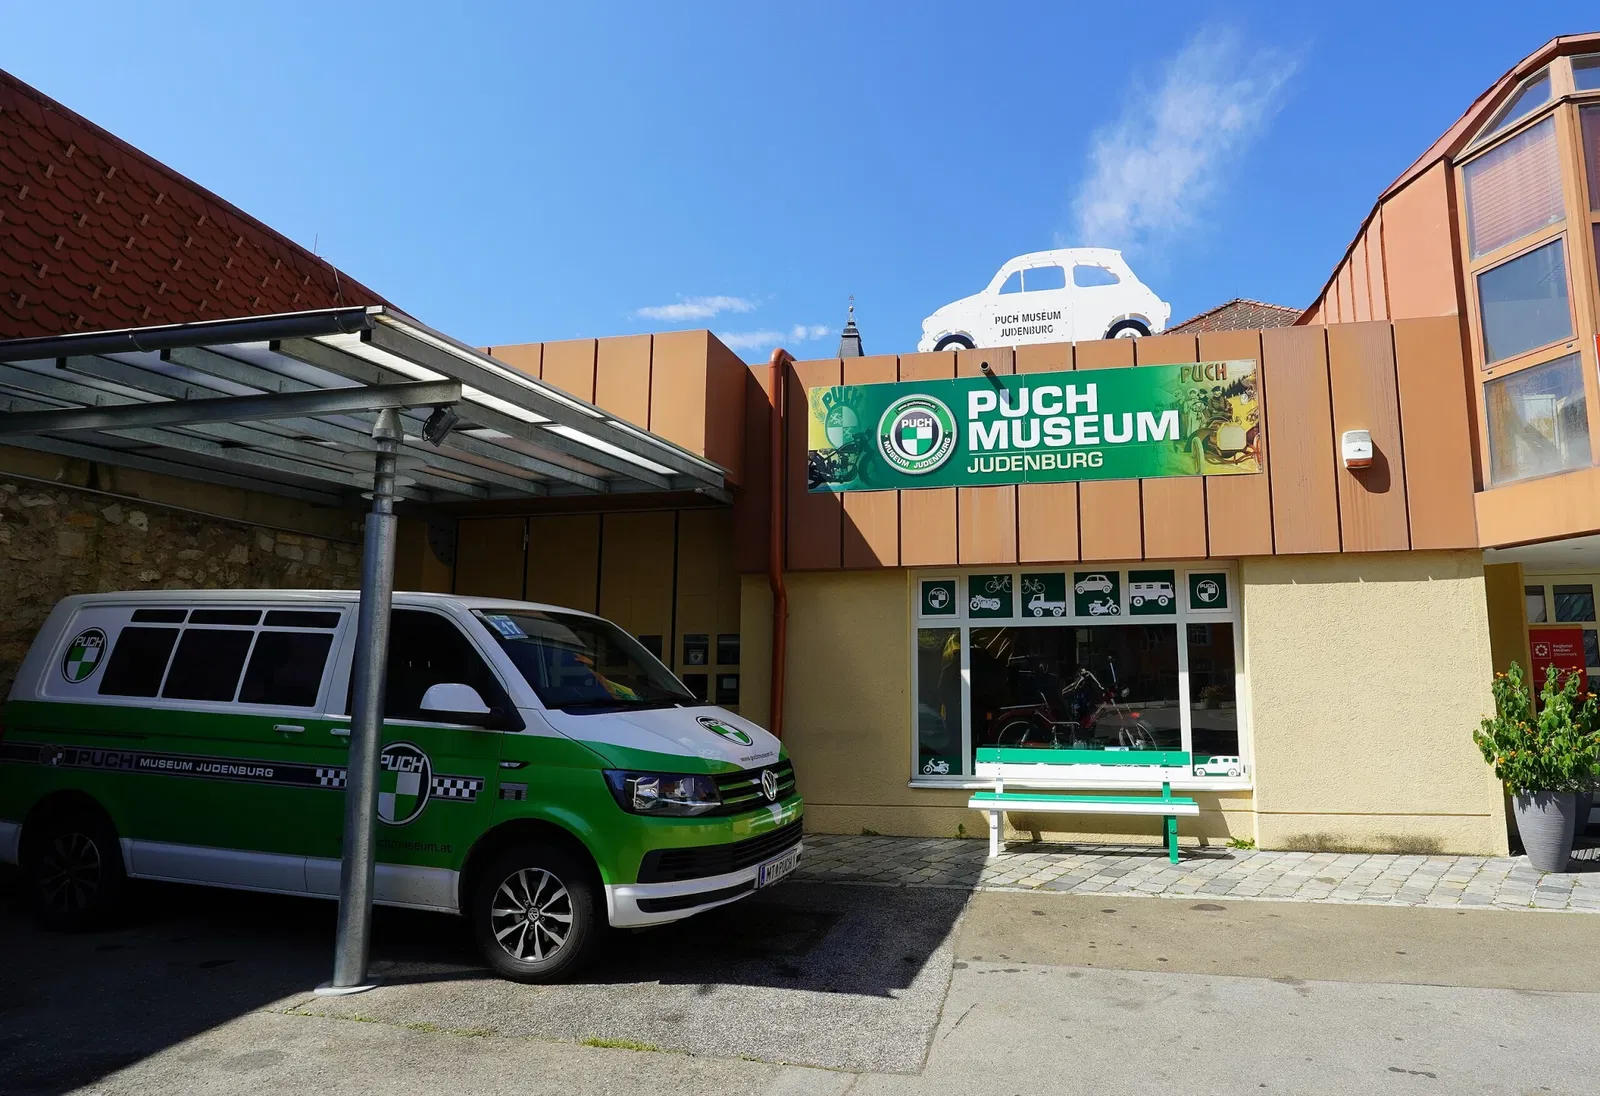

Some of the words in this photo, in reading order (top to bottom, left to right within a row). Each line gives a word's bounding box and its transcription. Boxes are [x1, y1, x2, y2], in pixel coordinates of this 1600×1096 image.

[995, 314, 1019, 325] PUCH
[1021, 310, 1061, 323] MUSEUM
[1000, 324, 1054, 338] JUDENBURG
[1180, 362, 1228, 384] PUCH
[967, 382, 1098, 420] PUCH
[901, 417, 933, 429] PUCH
[968, 409, 1181, 451] MUSEUM
[883, 440, 910, 468] MUSEUM
[913, 437, 951, 469] JUDENBURG
[967, 451, 1104, 474] JUDENBURG
[74, 636, 104, 647] PUCH
[78, 751, 133, 769] PUCH
[139, 757, 193, 771] MUSEUM
[195, 762, 274, 778] JUDENBURG
